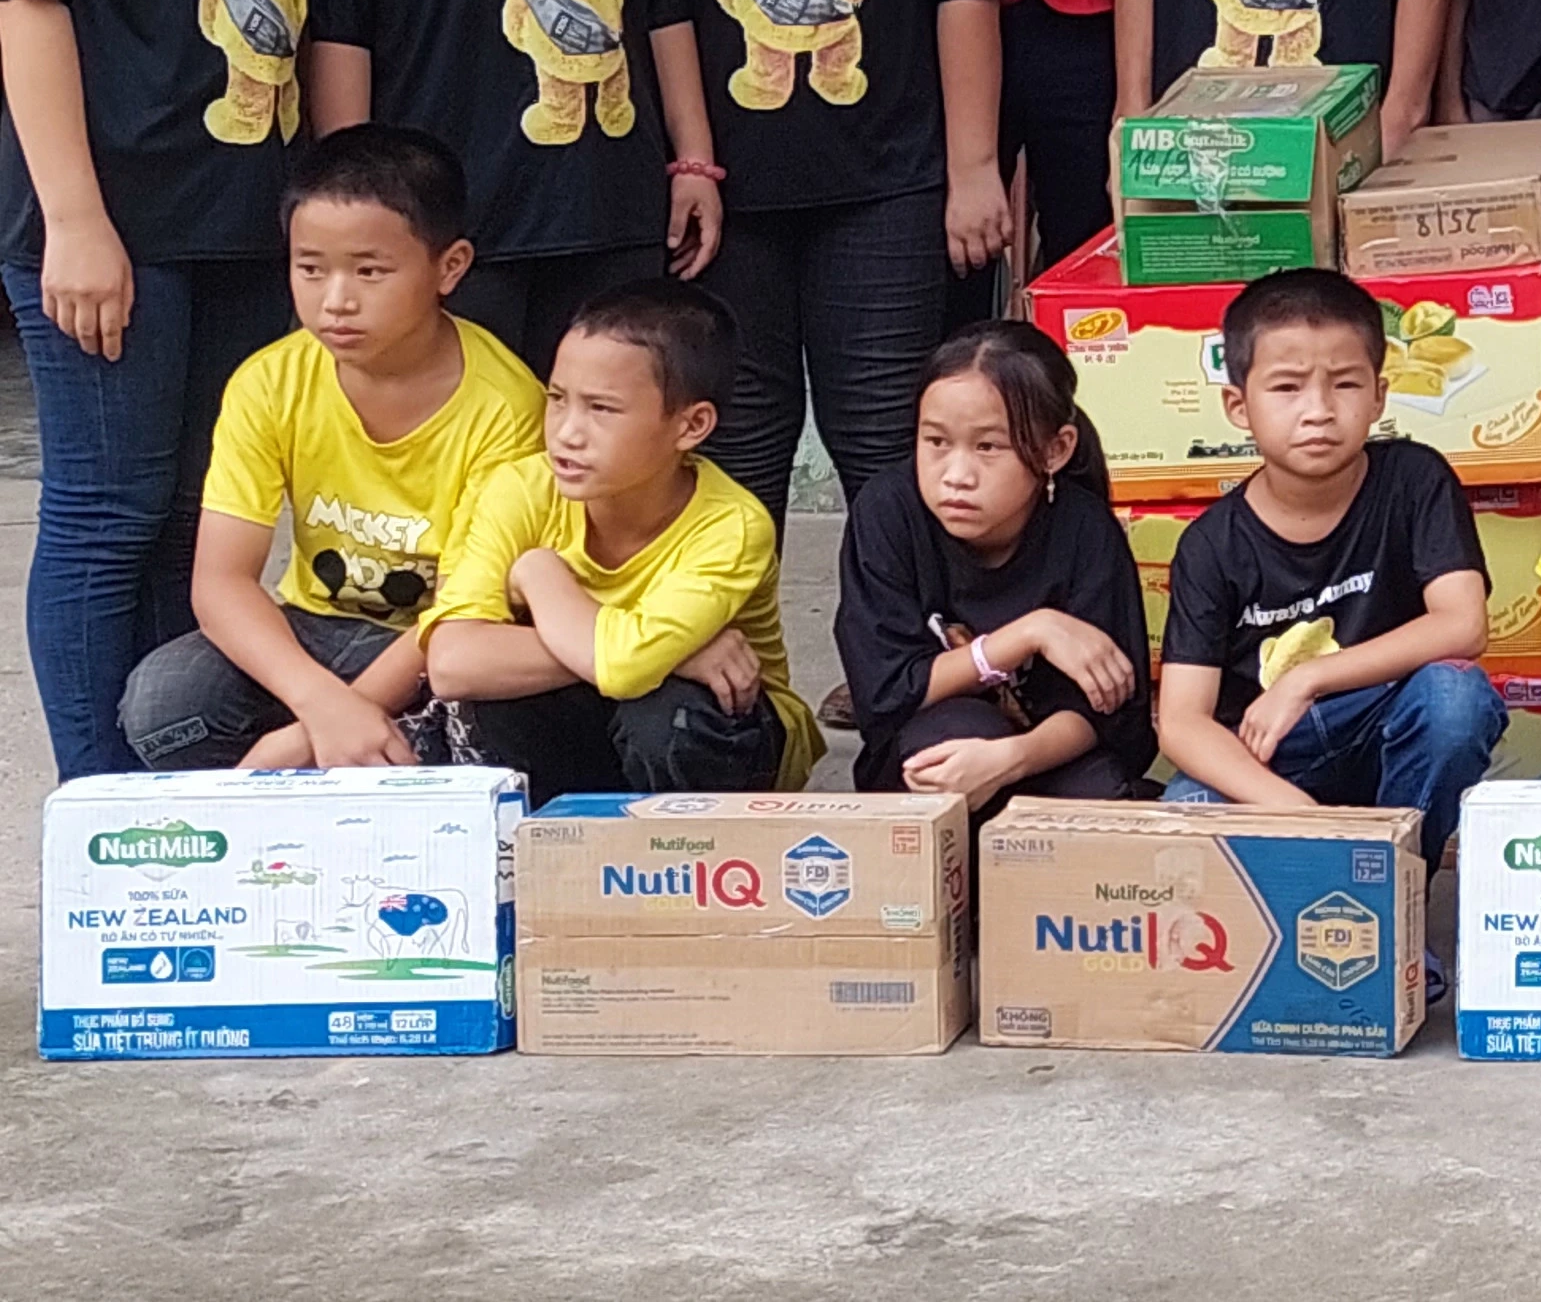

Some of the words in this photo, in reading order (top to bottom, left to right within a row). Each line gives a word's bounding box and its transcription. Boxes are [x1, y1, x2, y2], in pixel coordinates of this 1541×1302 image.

[1131, 129, 1175, 150] MB
[305, 493, 433, 555] MICKEY
[98, 834, 217, 861] NutiMilk
[650, 837, 715, 853] Nutifood
[1096, 883, 1174, 906] Nutifood
[68, 908, 127, 930] NEW
[133, 904, 247, 928] ZEALAND
[1484, 913, 1540, 931] NEW
[1324, 928, 1352, 943] FDI
[1083, 958, 1145, 973] GOLD
